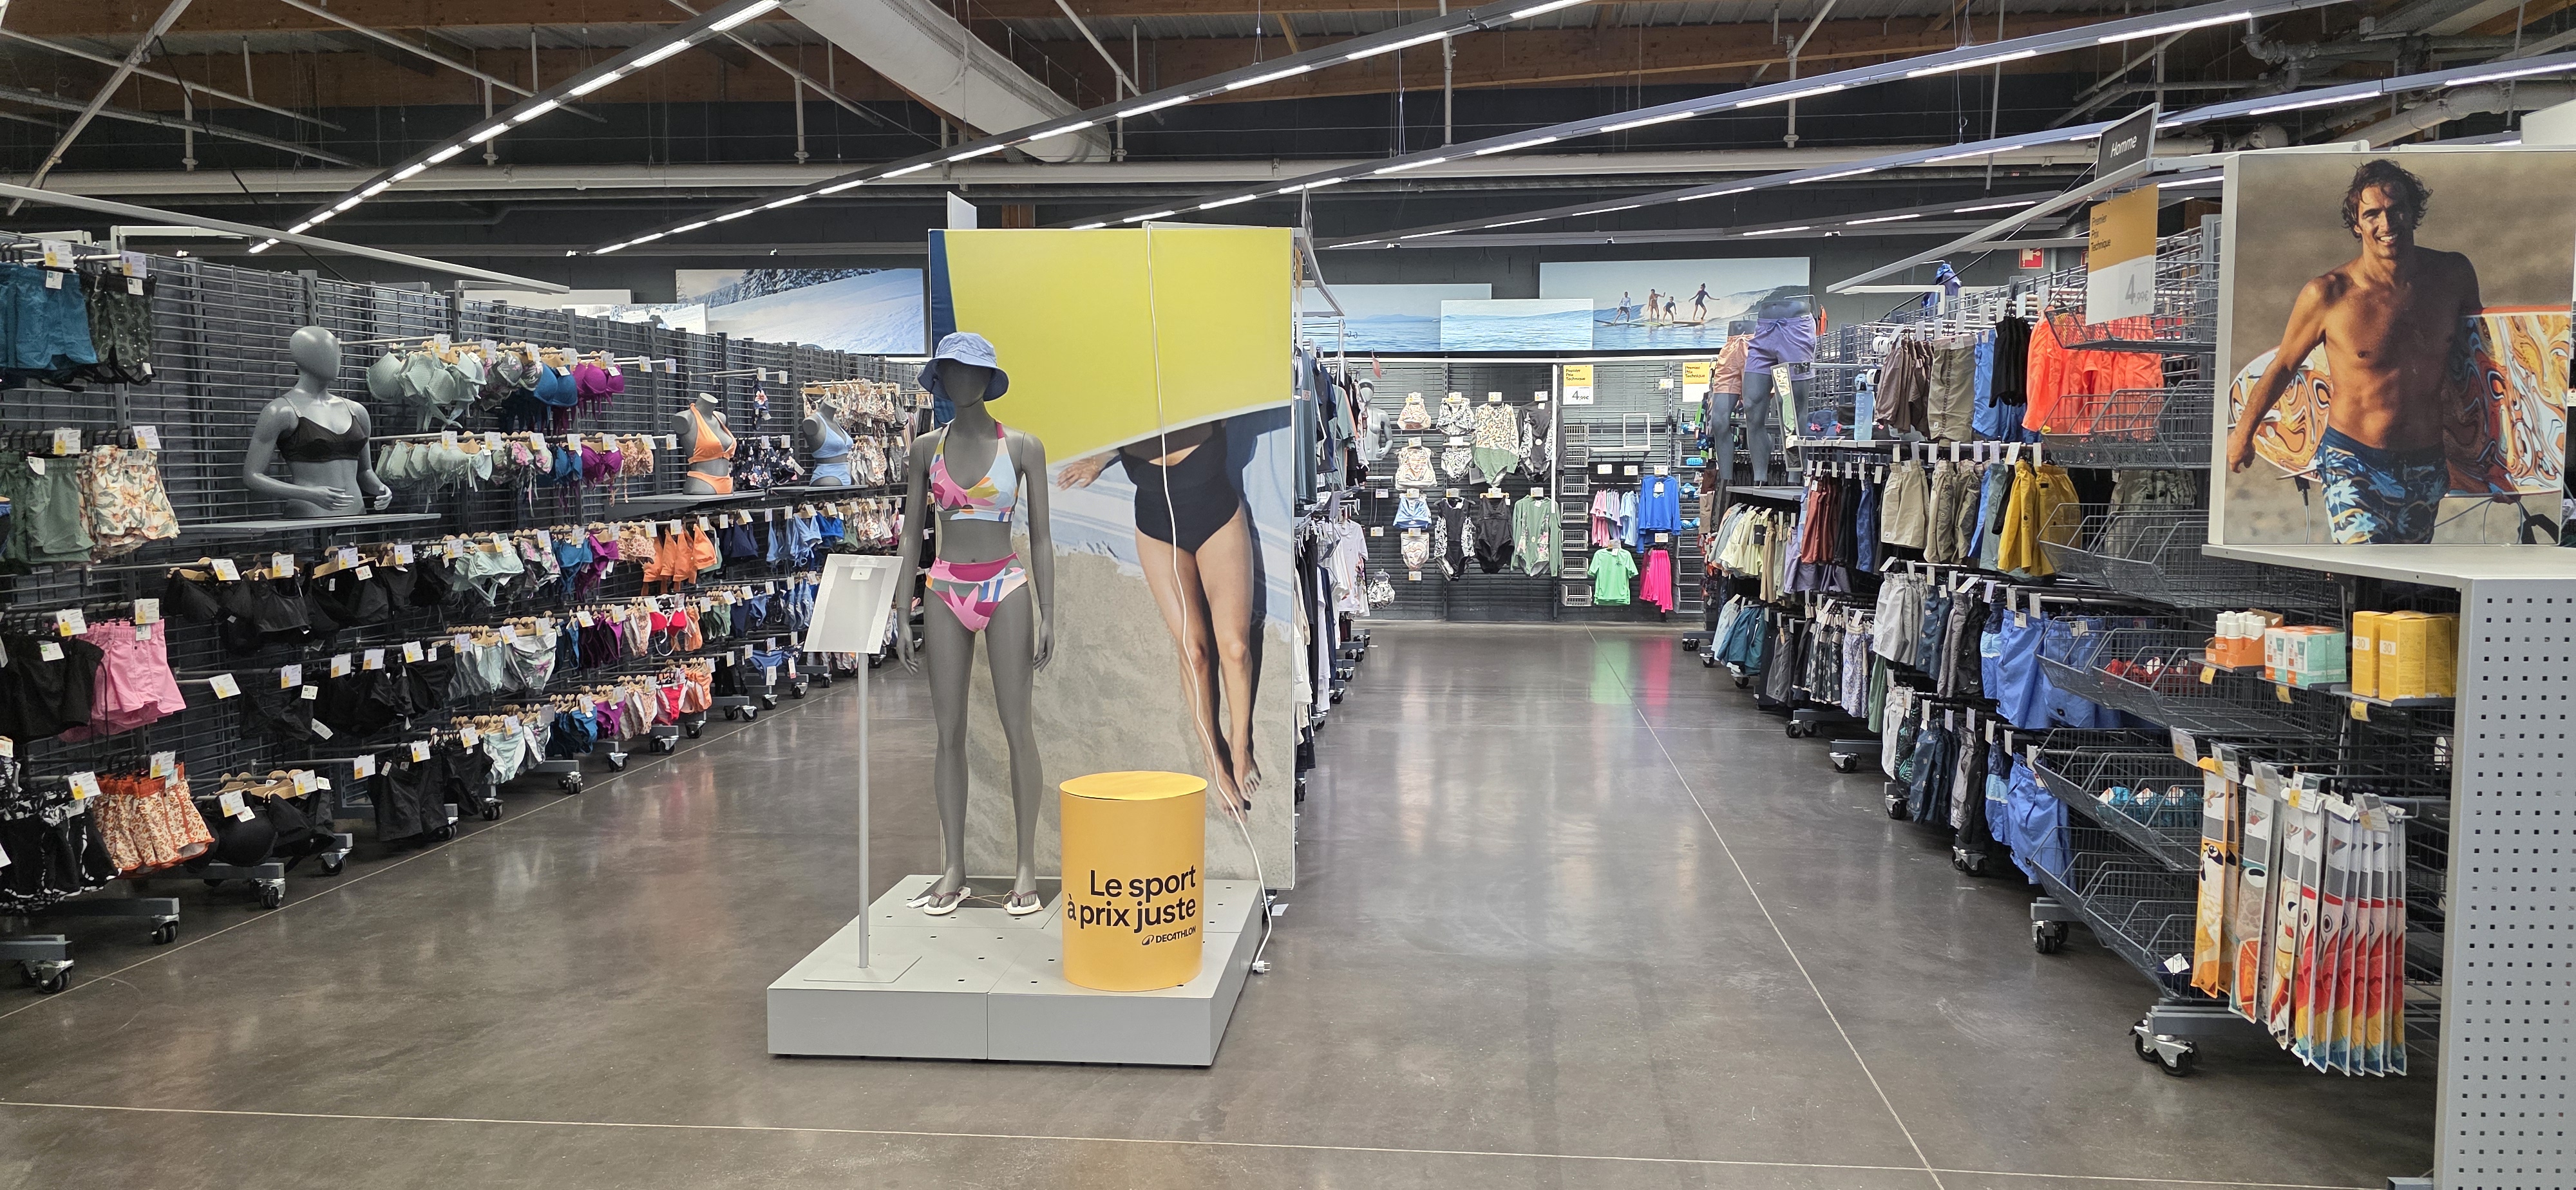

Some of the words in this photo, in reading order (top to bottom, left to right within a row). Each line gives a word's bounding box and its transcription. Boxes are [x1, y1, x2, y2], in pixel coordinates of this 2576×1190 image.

[2110, 134, 2137, 158] Homme
[2092, 214, 2108, 227] Premier
[2091, 229, 2099, 240] Prix
[2091, 238, 2112, 252] Technique
[2125, 274, 2149, 306] 4,99€
[2356, 638, 2365, 648] 30
[2383, 643, 2392, 654] 30
[1090, 869, 1122, 898] Le
[1128, 865, 1197, 903] sport
[1067, 893, 1077, 921] à
[1080, 901, 1130, 929] prix
[1134, 897, 1197, 933] juste
[1155, 925, 1197, 944] DECATHLON
